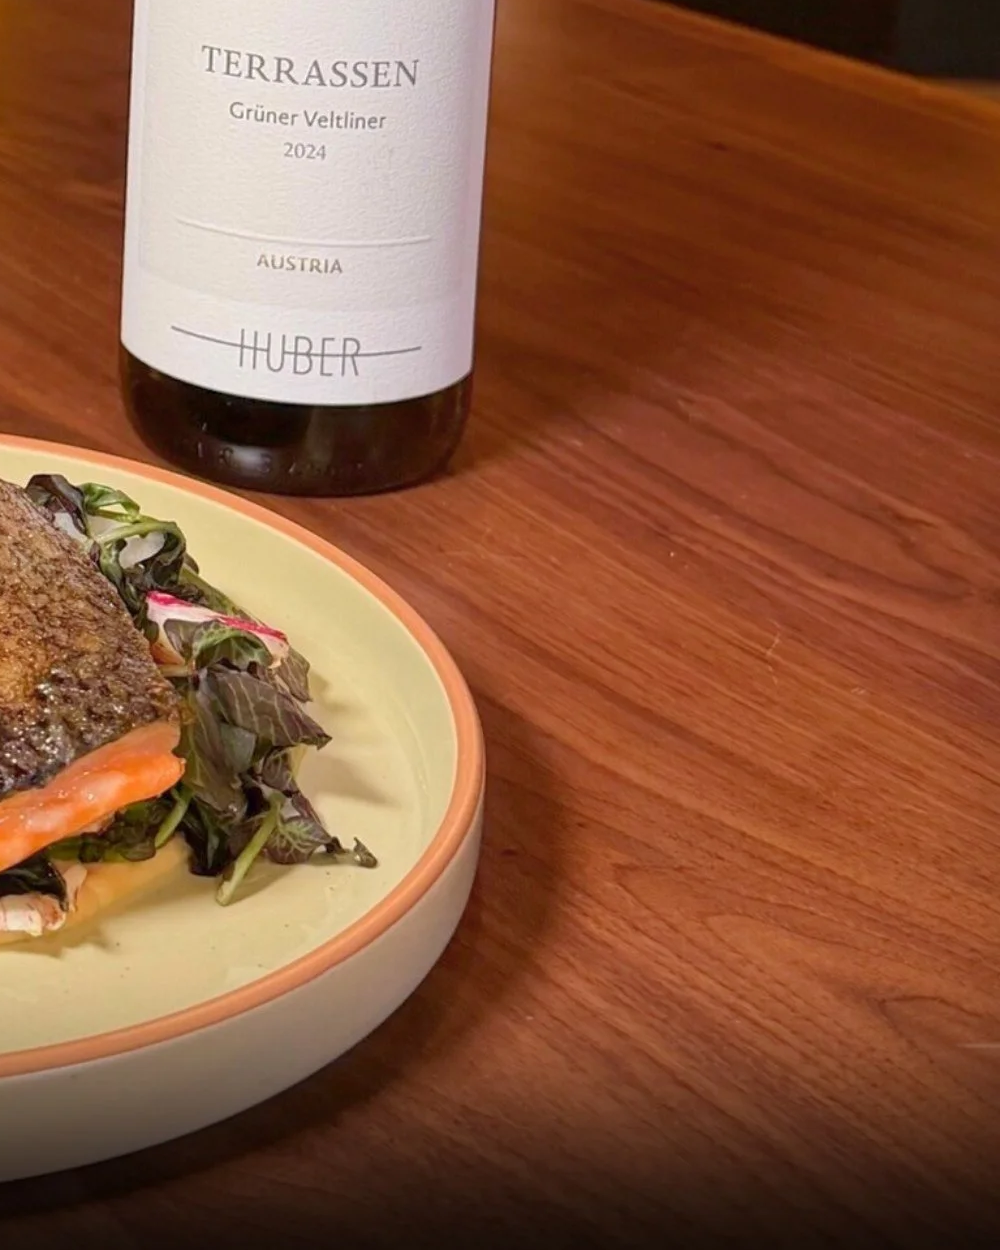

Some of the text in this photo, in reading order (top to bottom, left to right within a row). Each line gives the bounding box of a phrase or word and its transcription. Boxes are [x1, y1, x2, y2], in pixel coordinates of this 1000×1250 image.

[201, 44, 420, 88] TERRASSEN
[229, 101, 387, 130] Grüner Veltliner
[283, 141, 327, 161] 2024
[256, 253, 343, 275] AUSTRIA
[238, 327, 362, 378] HUBER
